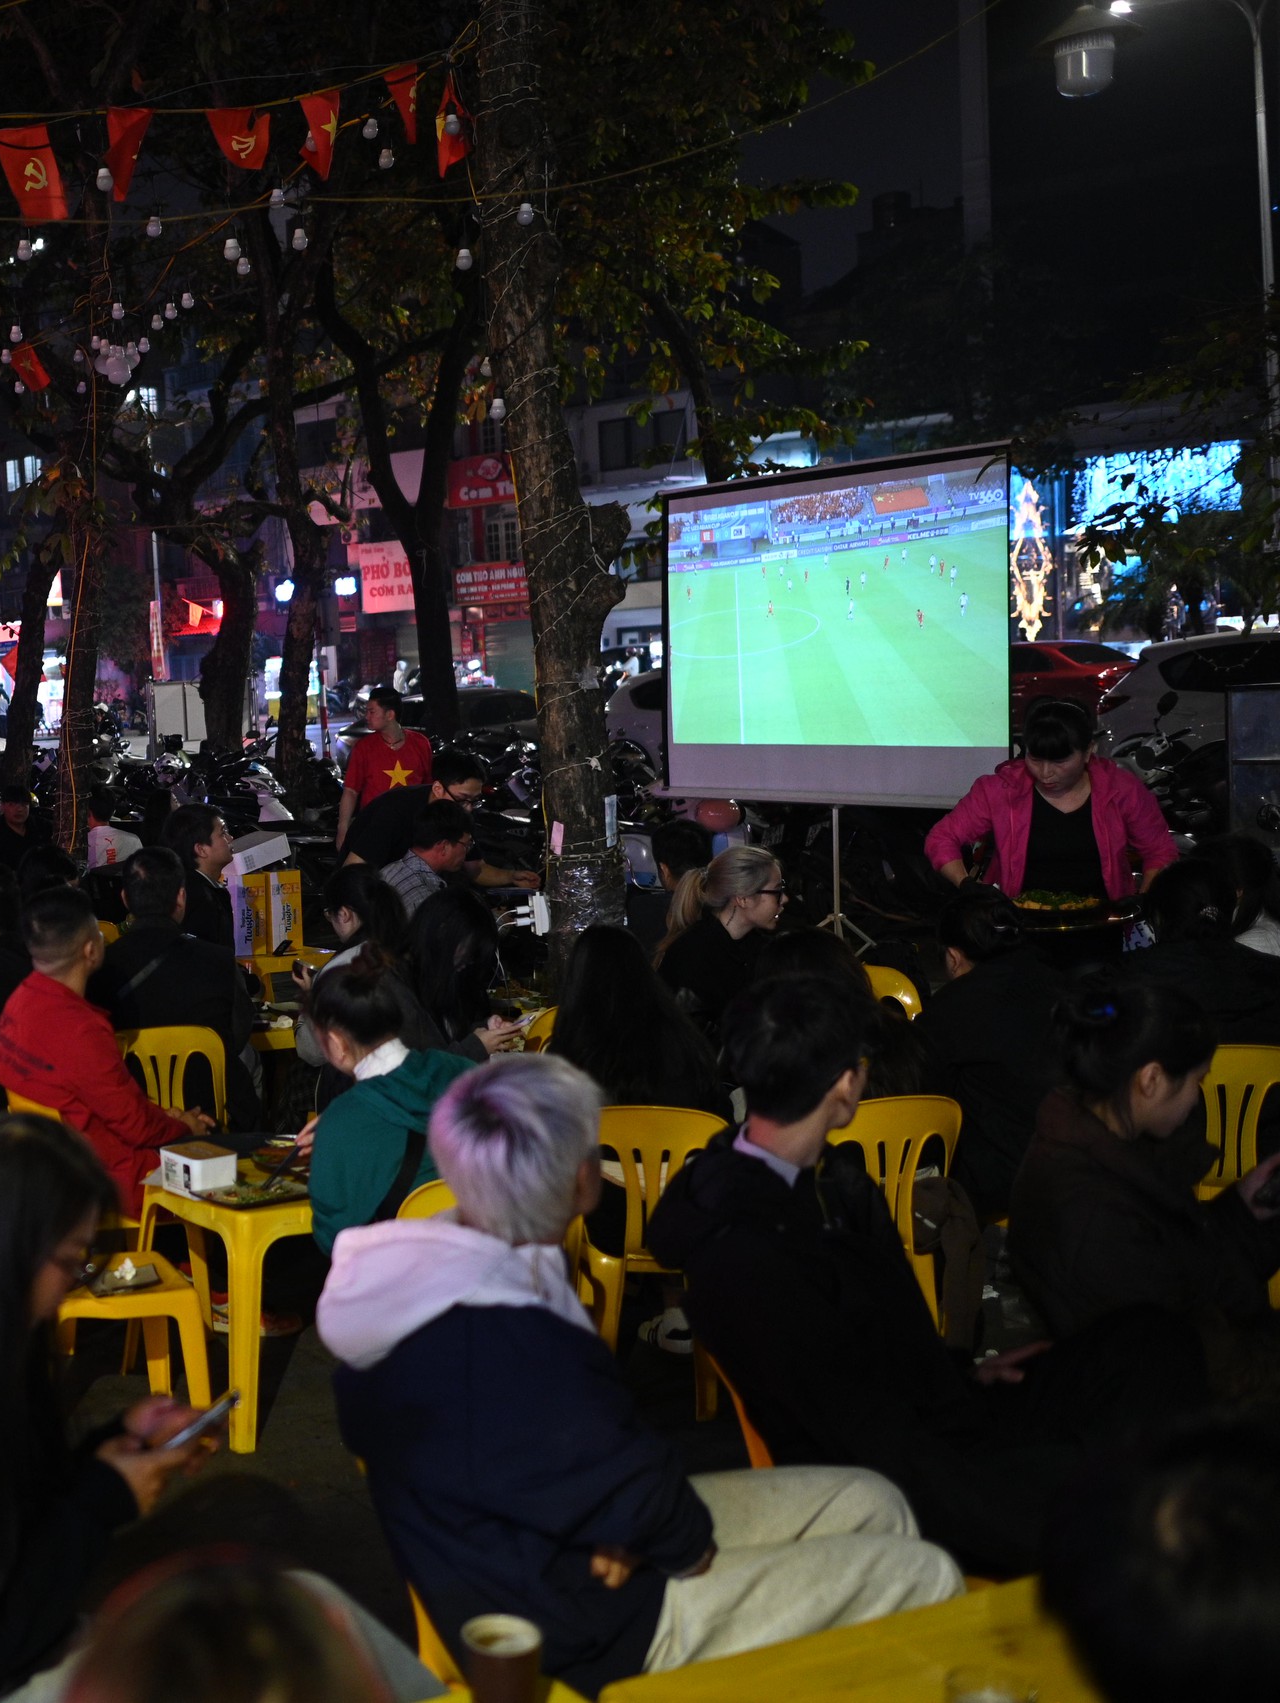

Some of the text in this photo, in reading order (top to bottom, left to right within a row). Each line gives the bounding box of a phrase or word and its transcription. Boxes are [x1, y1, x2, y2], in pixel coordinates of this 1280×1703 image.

[968, 488, 1004, 504] TV360
[907, 531, 930, 540] KELME
[833, 543, 848, 551] QATAR
[489, 567, 506, 580] ANH
[397, 583, 414, 595] RA
[285, 902, 293, 933] Twister
[245, 906, 254, 944] Twister
